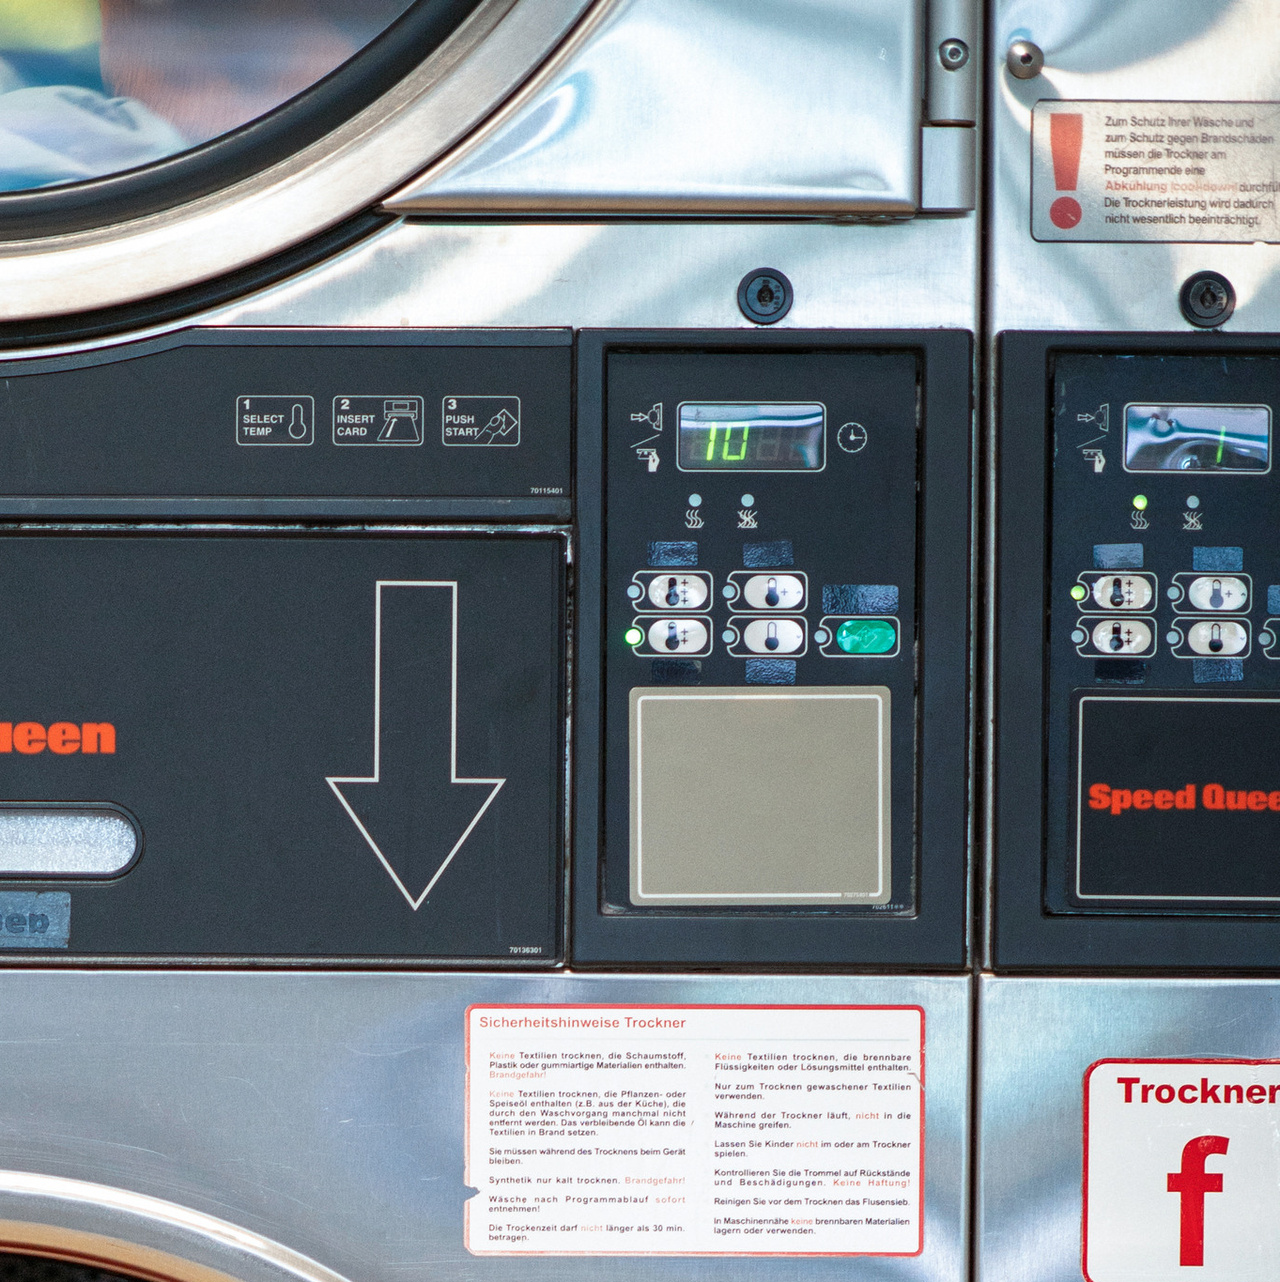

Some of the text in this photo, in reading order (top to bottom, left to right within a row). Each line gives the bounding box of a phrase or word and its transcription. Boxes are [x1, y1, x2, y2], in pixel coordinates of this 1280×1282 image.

[1105, 116, 1128, 127] Zum
[1130, 116, 1166, 127] Schutz
[1168, 117, 1191, 127] Ihrer
[1235, 117, 1254, 127] und
[1105, 132, 1274, 145] zum Schutz gegen Brandschäden
[1105, 148, 1227, 160] müssen die Trockner am
[1104, 164, 1206, 177] Programmende eine
[1104, 197, 1274, 211] Die Trocknerleistung wird dadurch
[1105, 214, 1262, 228] nicht wesentlich beeinträchtigt.
[243, 398, 250, 409] 1
[340, 398, 350, 409] 2
[447, 398, 457, 409] 3
[243, 414, 285, 424] SELECT
[337, 414, 375, 424] INSERT
[445, 414, 474, 424] PUSH
[243, 426, 272, 436] TEMP
[337, 426, 367, 436] CARD
[445, 427, 479, 436] START
[706, 421, 750, 461] 10
[1089, 783, 1280, 815] Speed Quee
[509, 946, 542, 954] 70136301
[480, 1017, 686, 1028] Sicherheitshinweise Trockner
[490, 1052, 686, 1060] Keine Textilien trocknen, die Schaumstoff,
[715, 1053, 911, 1062] Keine Textilien trocknen, die brennbare
[490, 1061, 517, 1069] Plastik
[541, 1062, 594, 1070] gummiartige
[596, 1062, 642, 1070] Materialien
[644, 1062, 686, 1070] enthalten.
[715, 1063, 774, 1072] Flüssigkeiten
[801, 1064, 864, 1072] Lösungsmittel
[868, 1064, 912, 1072] enthalten.
[490, 1071, 546, 1080] Brandgefahr!
[715, 1083, 731, 1091] Nur
[760, 1083, 802, 1091] Trocknen
[807, 1084, 868, 1092] gewaschener
[872, 1083, 911, 1091] Textilien
[1117, 1077, 1280, 1104] Trockner
[489, 1090, 686, 1099] Keine Textilien trocknen, die Pflanzen- oder
[715, 1093, 764, 1101] verwenden.
[490, 1100, 527, 1108] Speiseöl
[530, 1100, 572, 1108] enthalten
[575, 1100, 594, 1108] (z.B.
[618, 1100, 632, 1108] der
[636, 1100, 669, 1109] Küche),
[672, 1100, 686, 1108] die
[519, 1110, 536, 1118] den
[540, 1110, 608, 1118] Waschvorgang
[612, 1110, 659, 1119] manchmal
[663, 1110, 686, 1118] nicht
[489, 1119, 522, 1127] entfernt
[561, 1119, 577, 1127] Das
[638, 1118, 647, 1126] Öl
[673, 1120, 686, 1128] die
[1167, 1135, 1229, 1266] f
